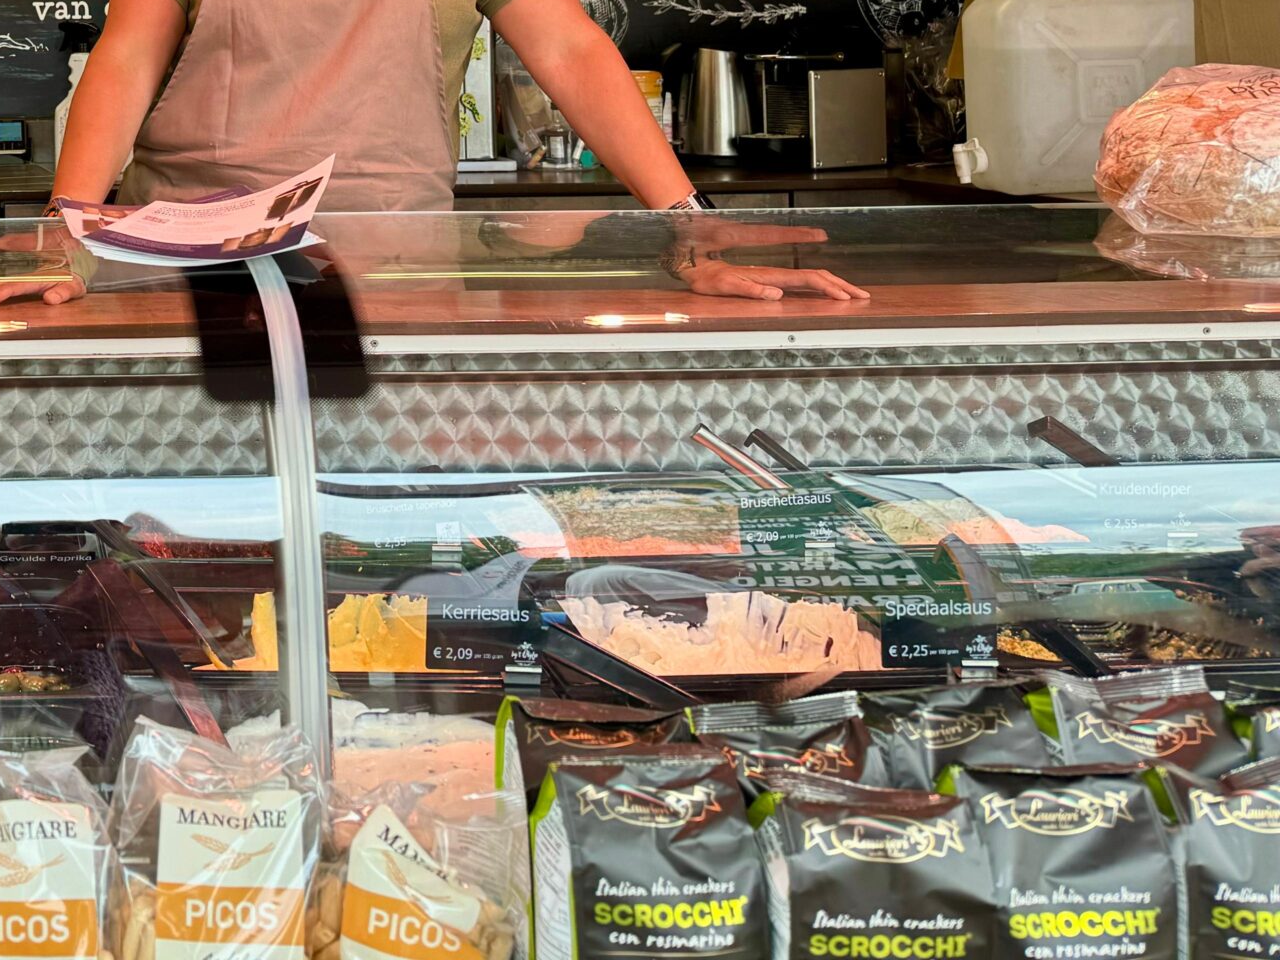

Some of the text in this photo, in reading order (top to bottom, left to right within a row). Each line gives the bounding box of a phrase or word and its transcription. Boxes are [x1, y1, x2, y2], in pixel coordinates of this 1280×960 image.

[32, 0, 92, 21] van
[1100, 482, 1192, 497] Kruidendipper
[740, 492, 832, 510] Bruschettasaus
[0, 554, 92, 563] Gevulde Paprika
[442, 603, 530, 622] Kerriesaus
[885, 599, 992, 620] Speciaalsaus
[433, 647, 442, 658] €
[445, 647, 473, 661] 2,09
[888, 644, 898, 657] €
[901, 644, 928, 659] 2,25
[176, 807, 288, 832] MANGIARE
[595, 876, 736, 897] Italian thin crackers
[1009, 884, 1152, 908] Italian thin crackers
[185, 898, 281, 931] PICOS
[594, 898, 746, 930] SCROCCHI
[813, 909, 965, 931] Italian thin crackers
[1009, 908, 1160, 940] SCROCCHI
[366, 906, 462, 953] PICOS
[609, 930, 735, 950] con rosmarino
[808, 933, 970, 960] SCROCCHI
[1025, 937, 1147, 959] con rosmarino
[1227, 936, 1263, 953] con
